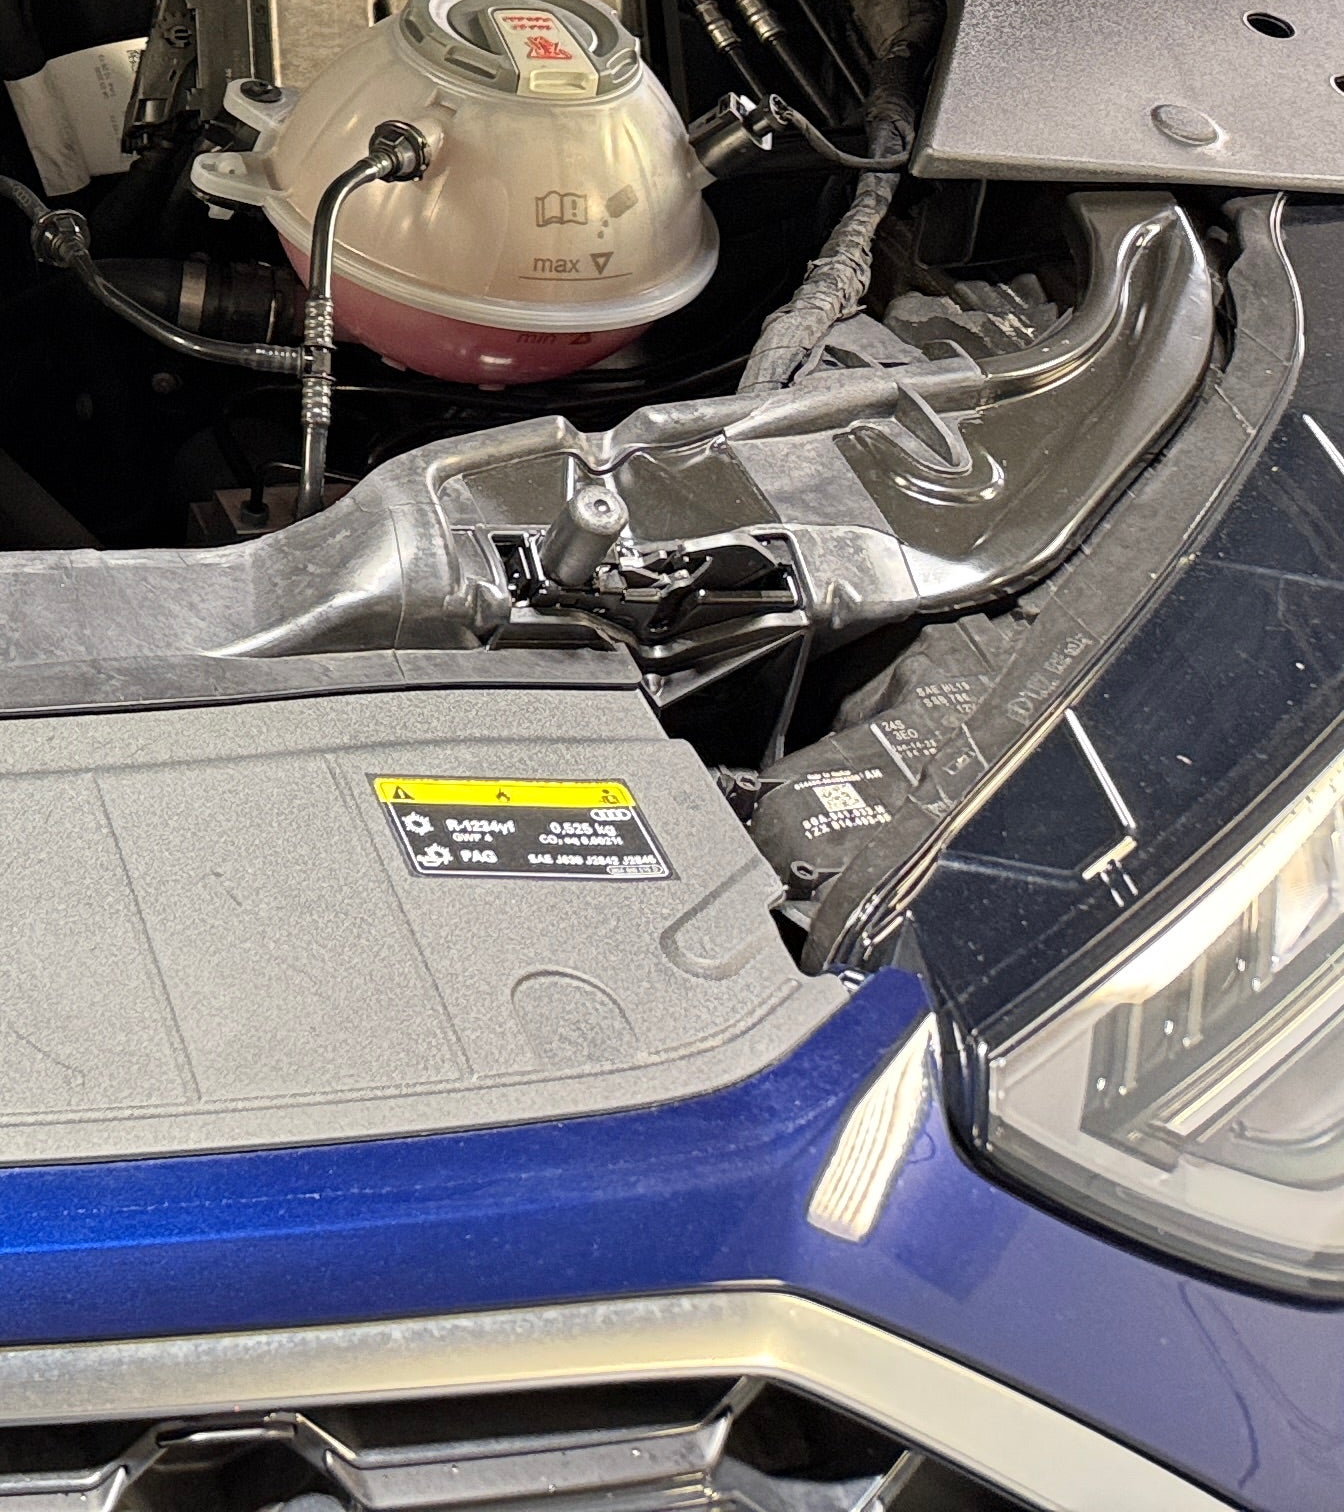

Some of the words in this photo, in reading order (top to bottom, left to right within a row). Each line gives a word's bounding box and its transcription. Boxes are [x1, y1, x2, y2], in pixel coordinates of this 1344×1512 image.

[533, 257, 580, 274] max
[516, 332, 556, 345] min
[881, 719, 905, 732] 24S
[445, 818, 516, 836] R-1234yf
[594, 822, 617, 837] kg
[452, 832, 482, 842] GWP
[460, 849, 498, 863] PAG
[527, 853, 554, 864] SAE
